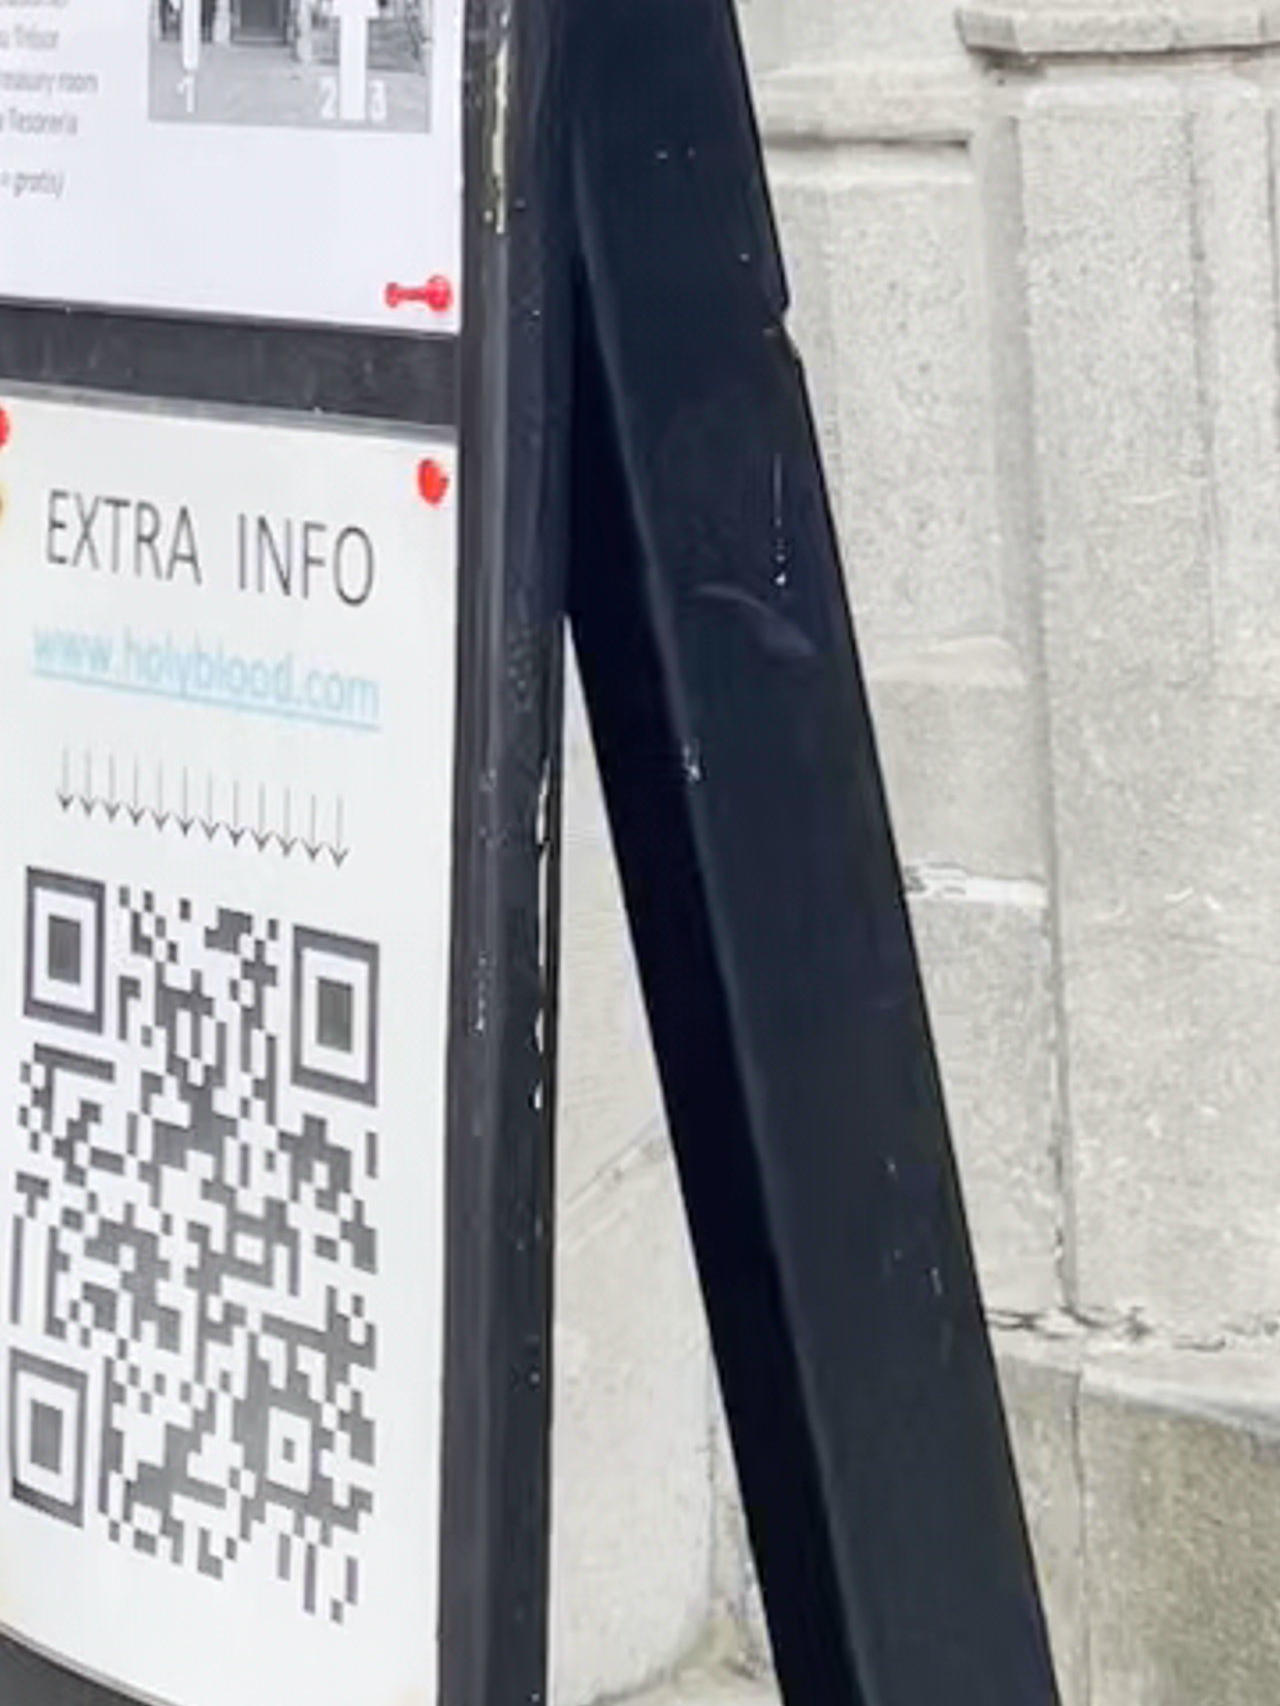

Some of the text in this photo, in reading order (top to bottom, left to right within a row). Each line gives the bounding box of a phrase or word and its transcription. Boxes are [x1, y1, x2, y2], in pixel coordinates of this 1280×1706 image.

[47, 489, 374, 606] EXTRA INFO
[33, 630, 378, 716] www.holyblood.com
